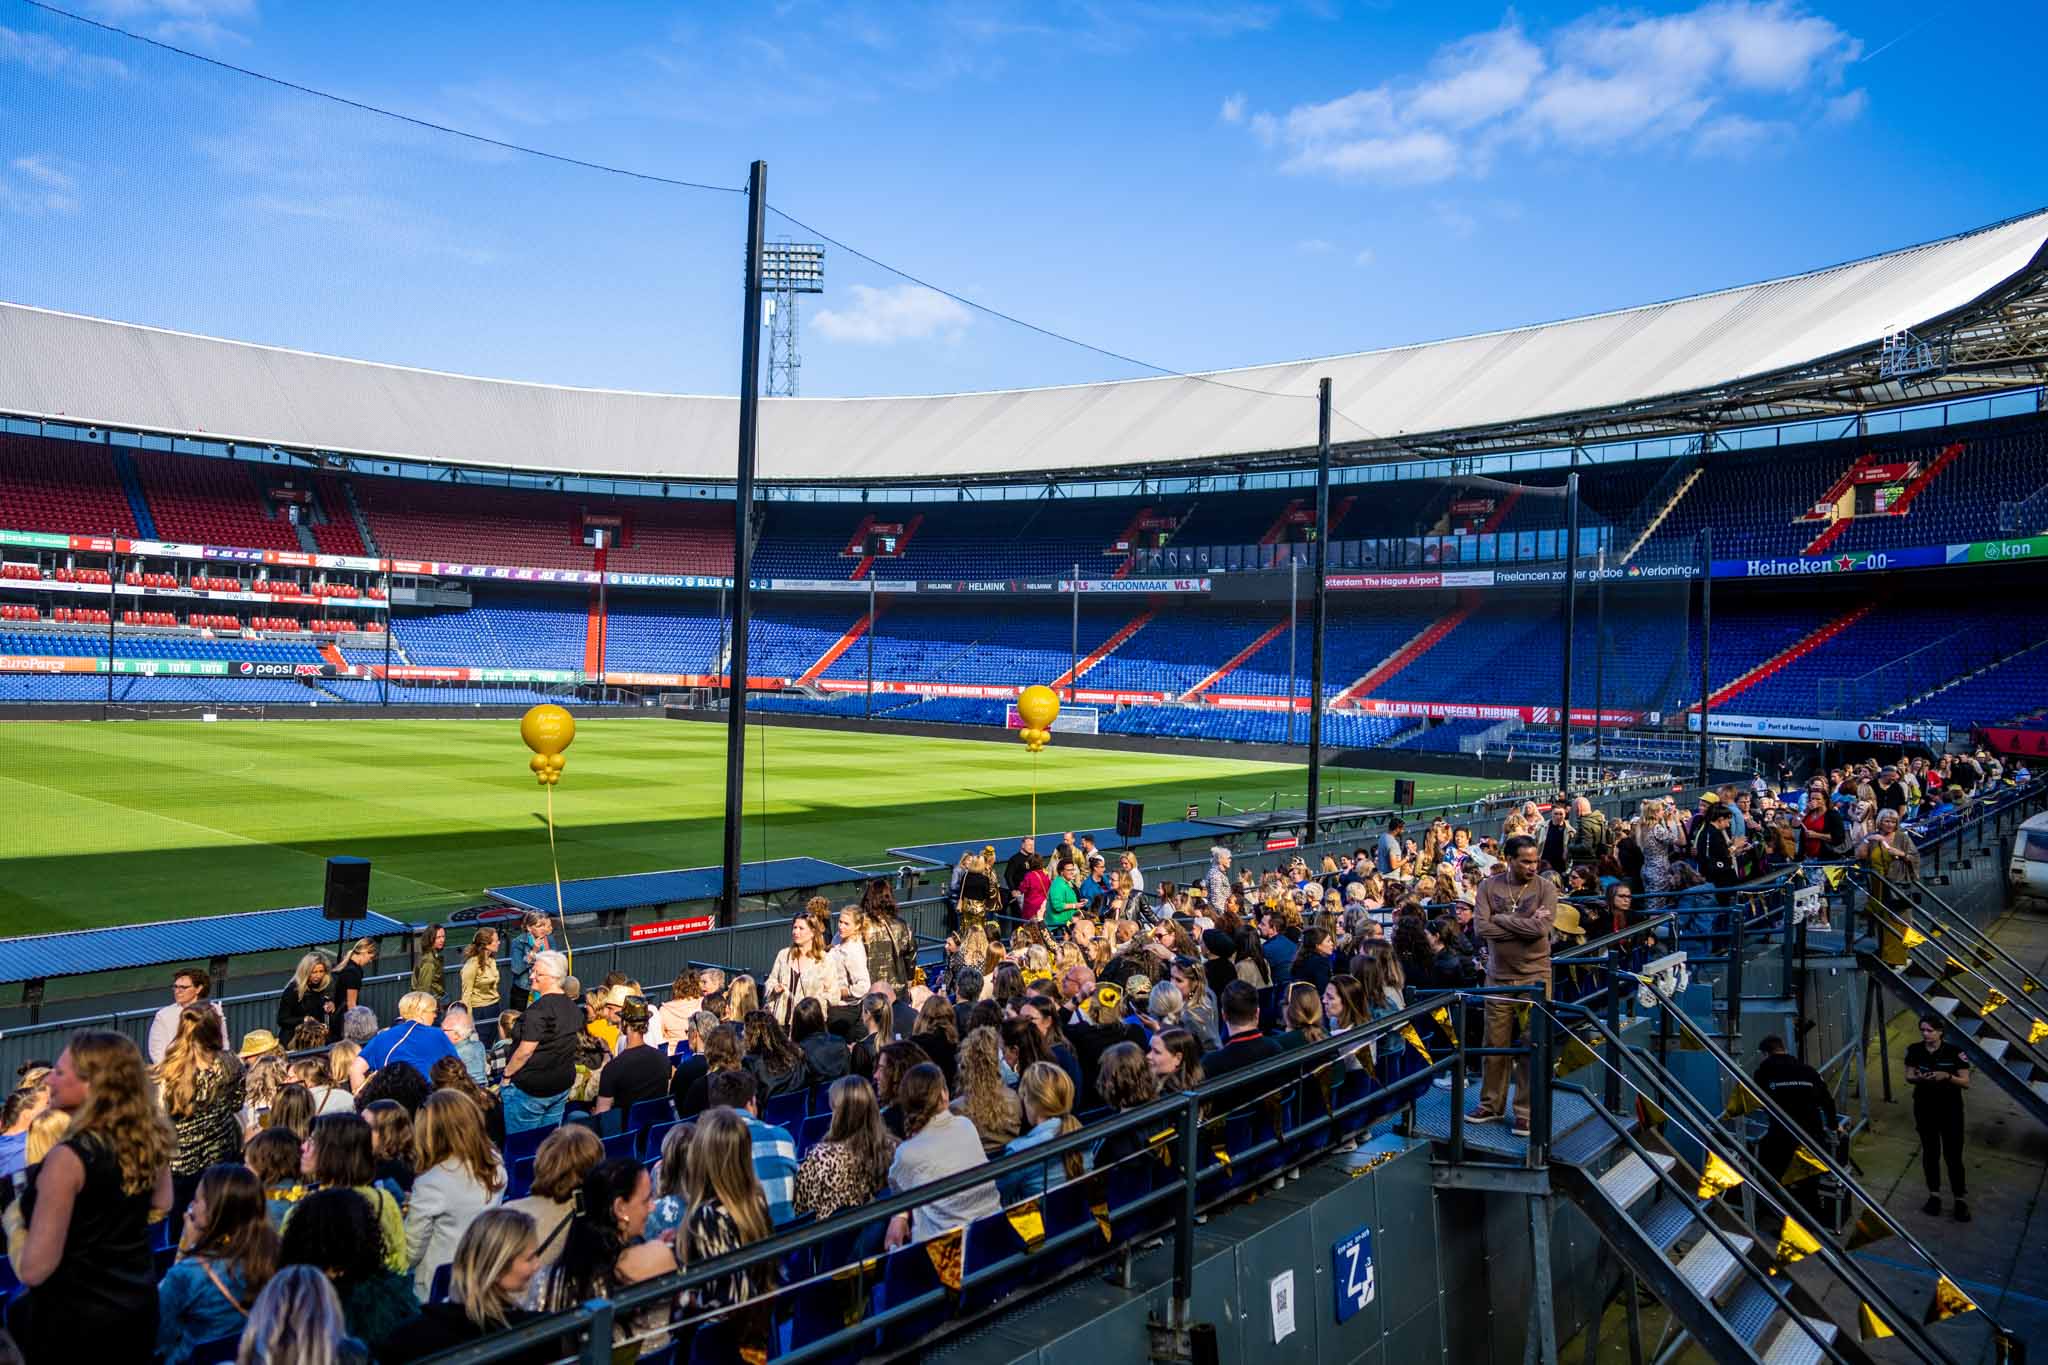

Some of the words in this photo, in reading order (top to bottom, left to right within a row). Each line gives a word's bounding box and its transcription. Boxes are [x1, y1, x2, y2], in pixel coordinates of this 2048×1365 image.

[2002, 543, 2031, 557] kpn
[1747, 558, 1832, 576] Heineken
[1325, 577, 1363, 586] otterdam
[1364, 577, 1379, 586] The
[1381, 576, 1407, 587] Hague
[1409, 575, 1439, 586] Airport
[1497, 571, 1550, 582] Freelancen
[968, 582, 1006, 591] HELMINK
[1100, 581, 1168, 591] SCHOONMAAK
[256, 663, 292, 675] pepsi
[294, 664, 324, 676] MAX
[1375, 703, 1409, 714] WILLEM
[1411, 704, 1429, 715] VAN
[1431, 705, 1476, 717] HANEGEM
[1478, 707, 1520, 719] TRIBUNE
[1346, 1243, 1362, 1298] Z
